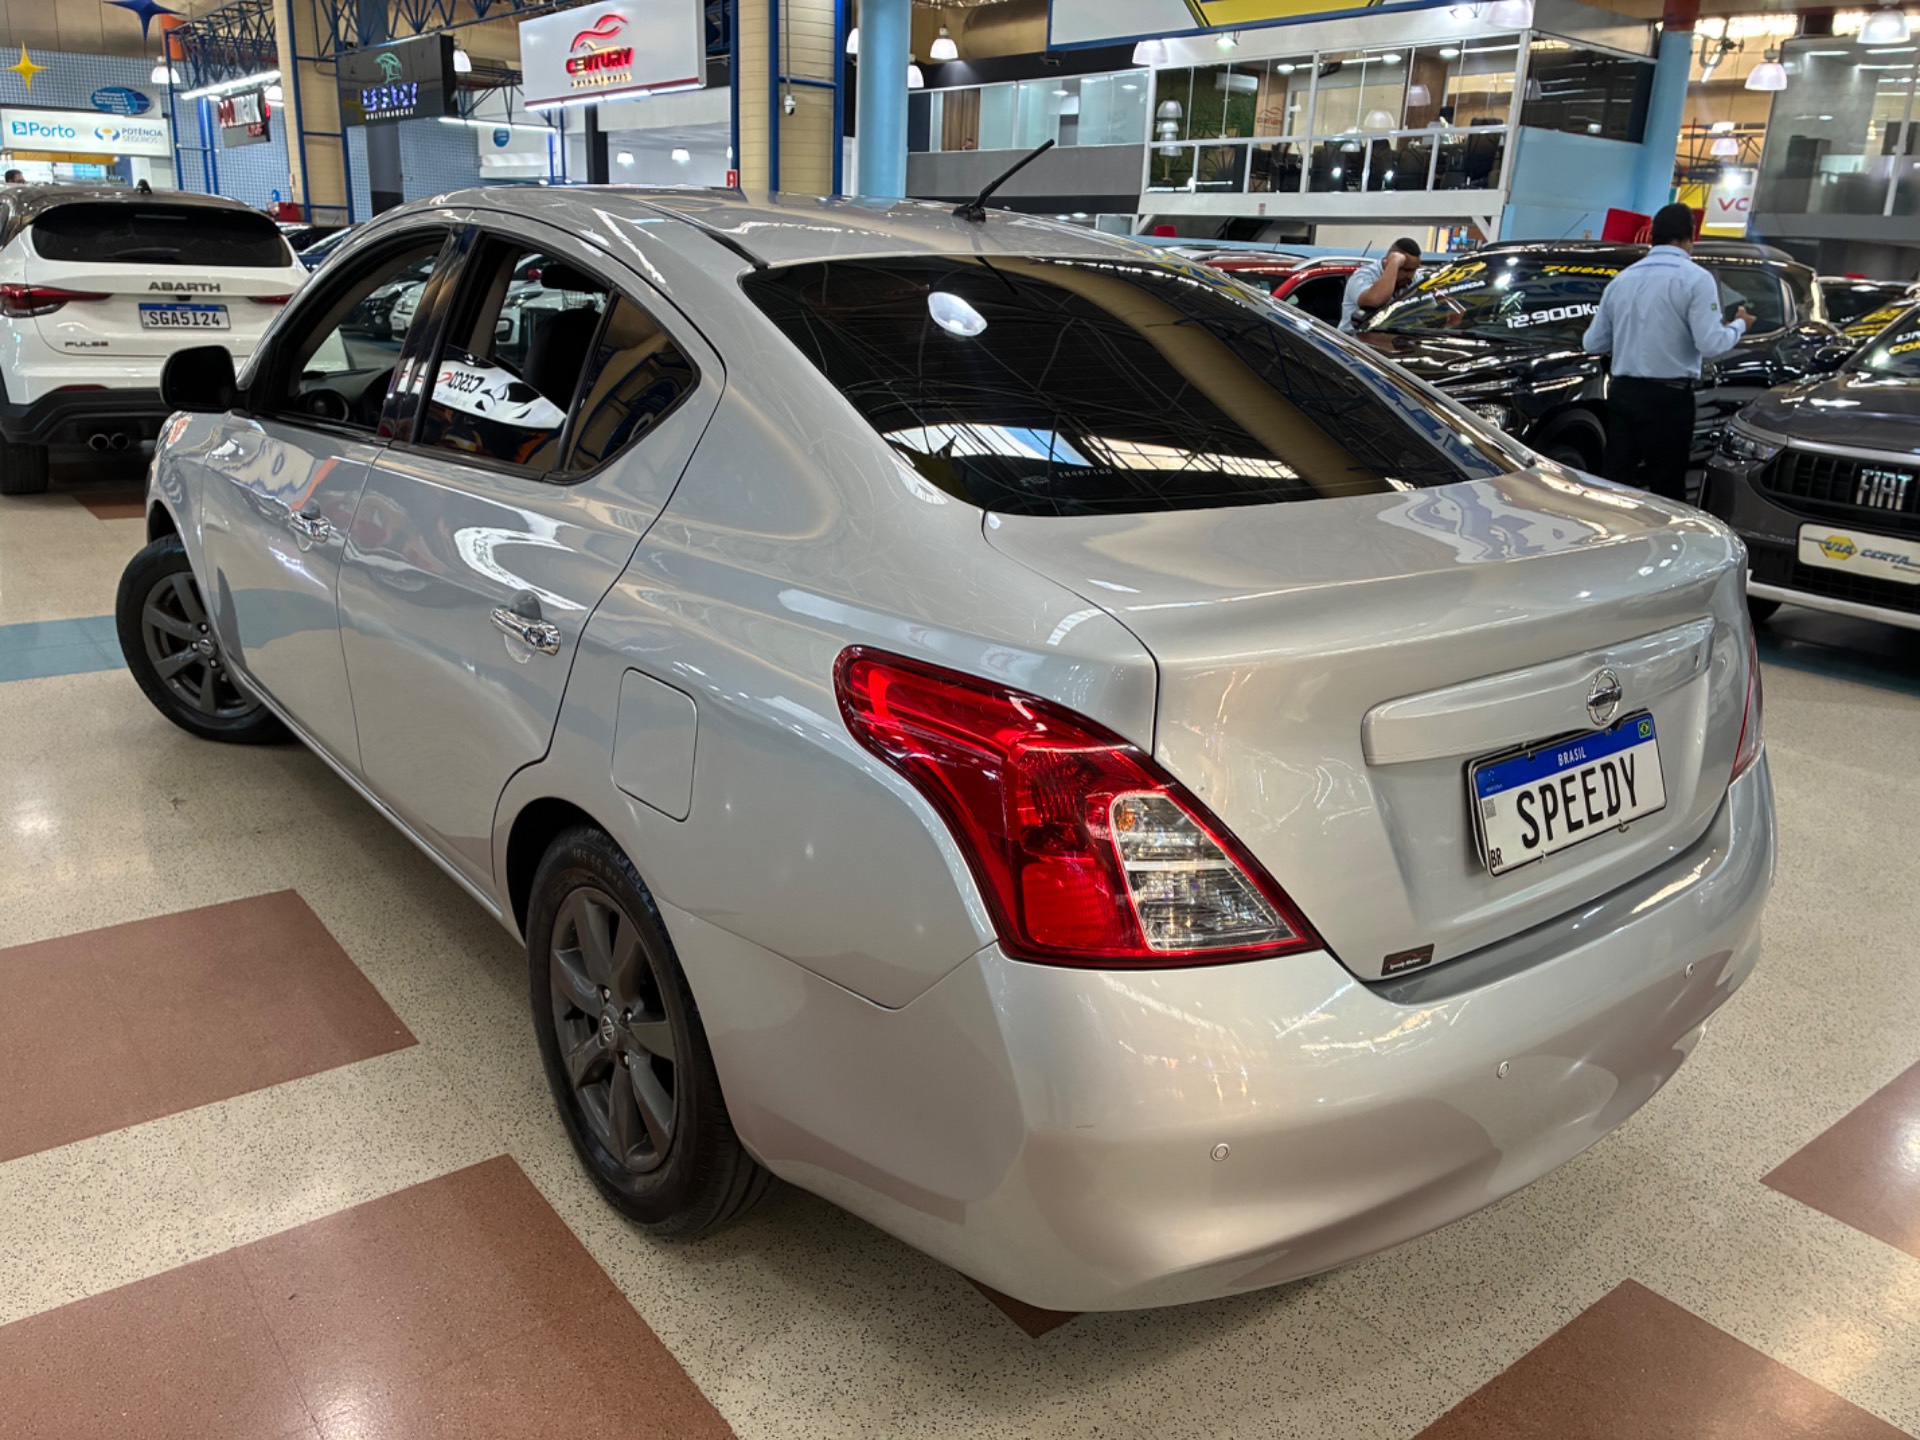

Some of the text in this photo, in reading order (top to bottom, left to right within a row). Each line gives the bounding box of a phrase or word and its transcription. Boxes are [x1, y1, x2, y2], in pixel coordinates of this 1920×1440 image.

[566, 47, 634, 76] CENTURY
[29, 121, 76, 138] Porto
[148, 281, 221, 293] ABARTH
[64, 340, 109, 348] PULSE
[1856, 468, 1914, 511] FIAT
[1557, 746, 1587, 767] BRASIL
[1516, 752, 1638, 850] SPEEDY
[1490, 847, 1504, 869] BR
